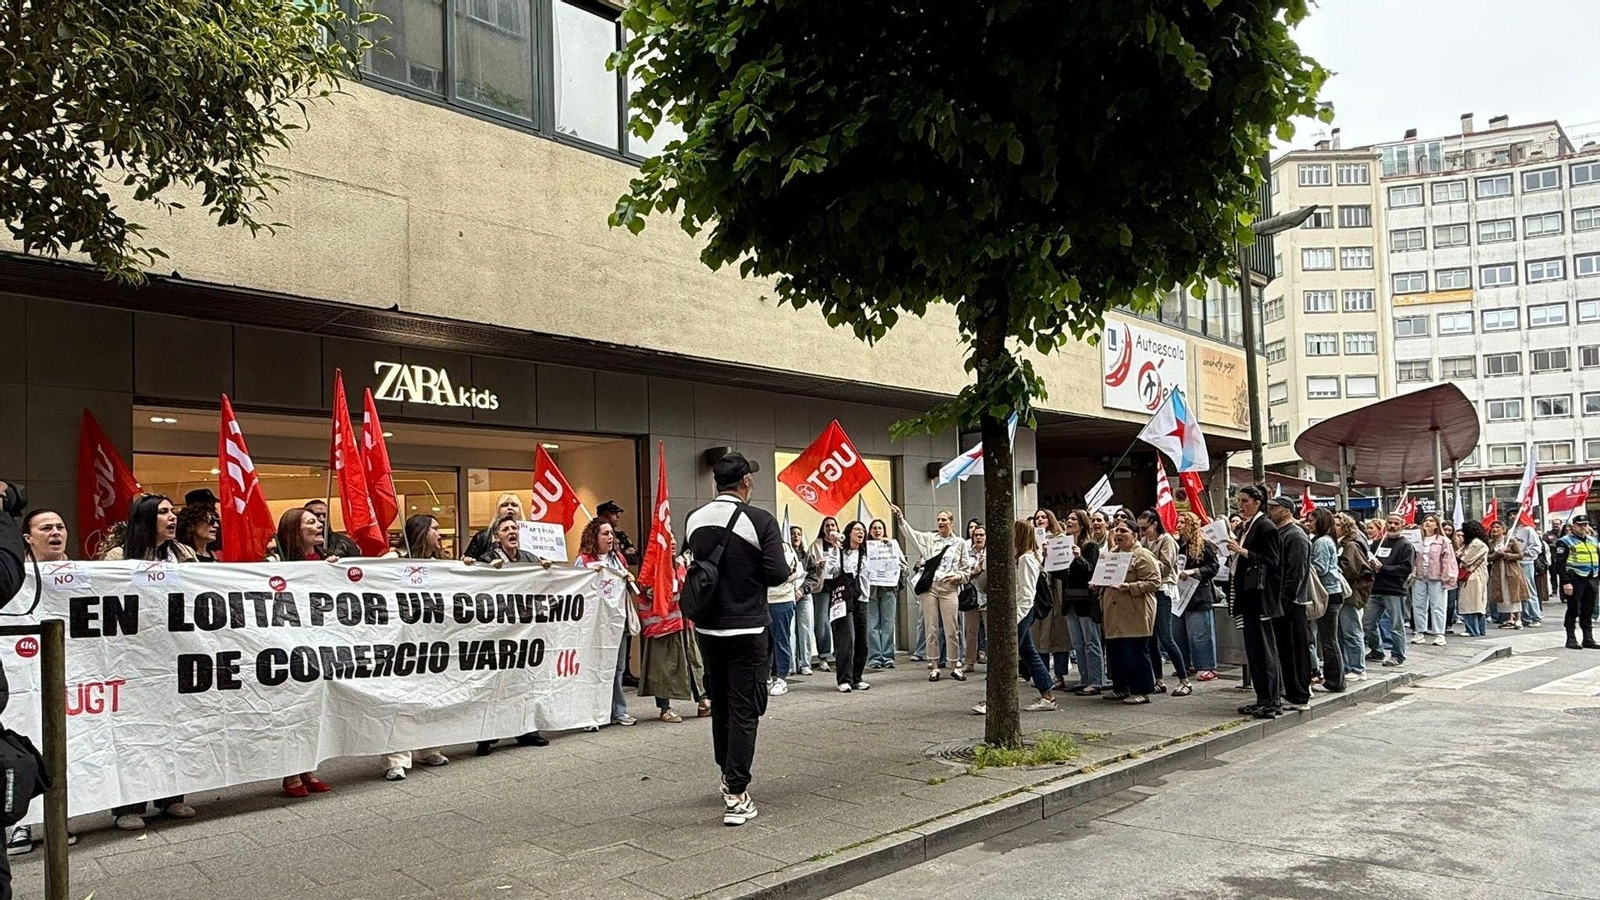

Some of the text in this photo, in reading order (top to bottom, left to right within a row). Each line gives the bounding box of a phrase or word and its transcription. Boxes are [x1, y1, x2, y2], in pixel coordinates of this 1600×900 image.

[1135, 333, 1185, 361] Autoescola
[374, 360, 499, 411] ZARA kids
[54, 574, 74, 585] NO
[147, 571, 166, 582] NO
[411, 576, 423, 585] NO
[69, 591, 585, 639] EN LOITA POR UN CONVENIO
[177, 638, 545, 694] DE COMERCIO VARIO
[65, 679, 126, 716] UGT
